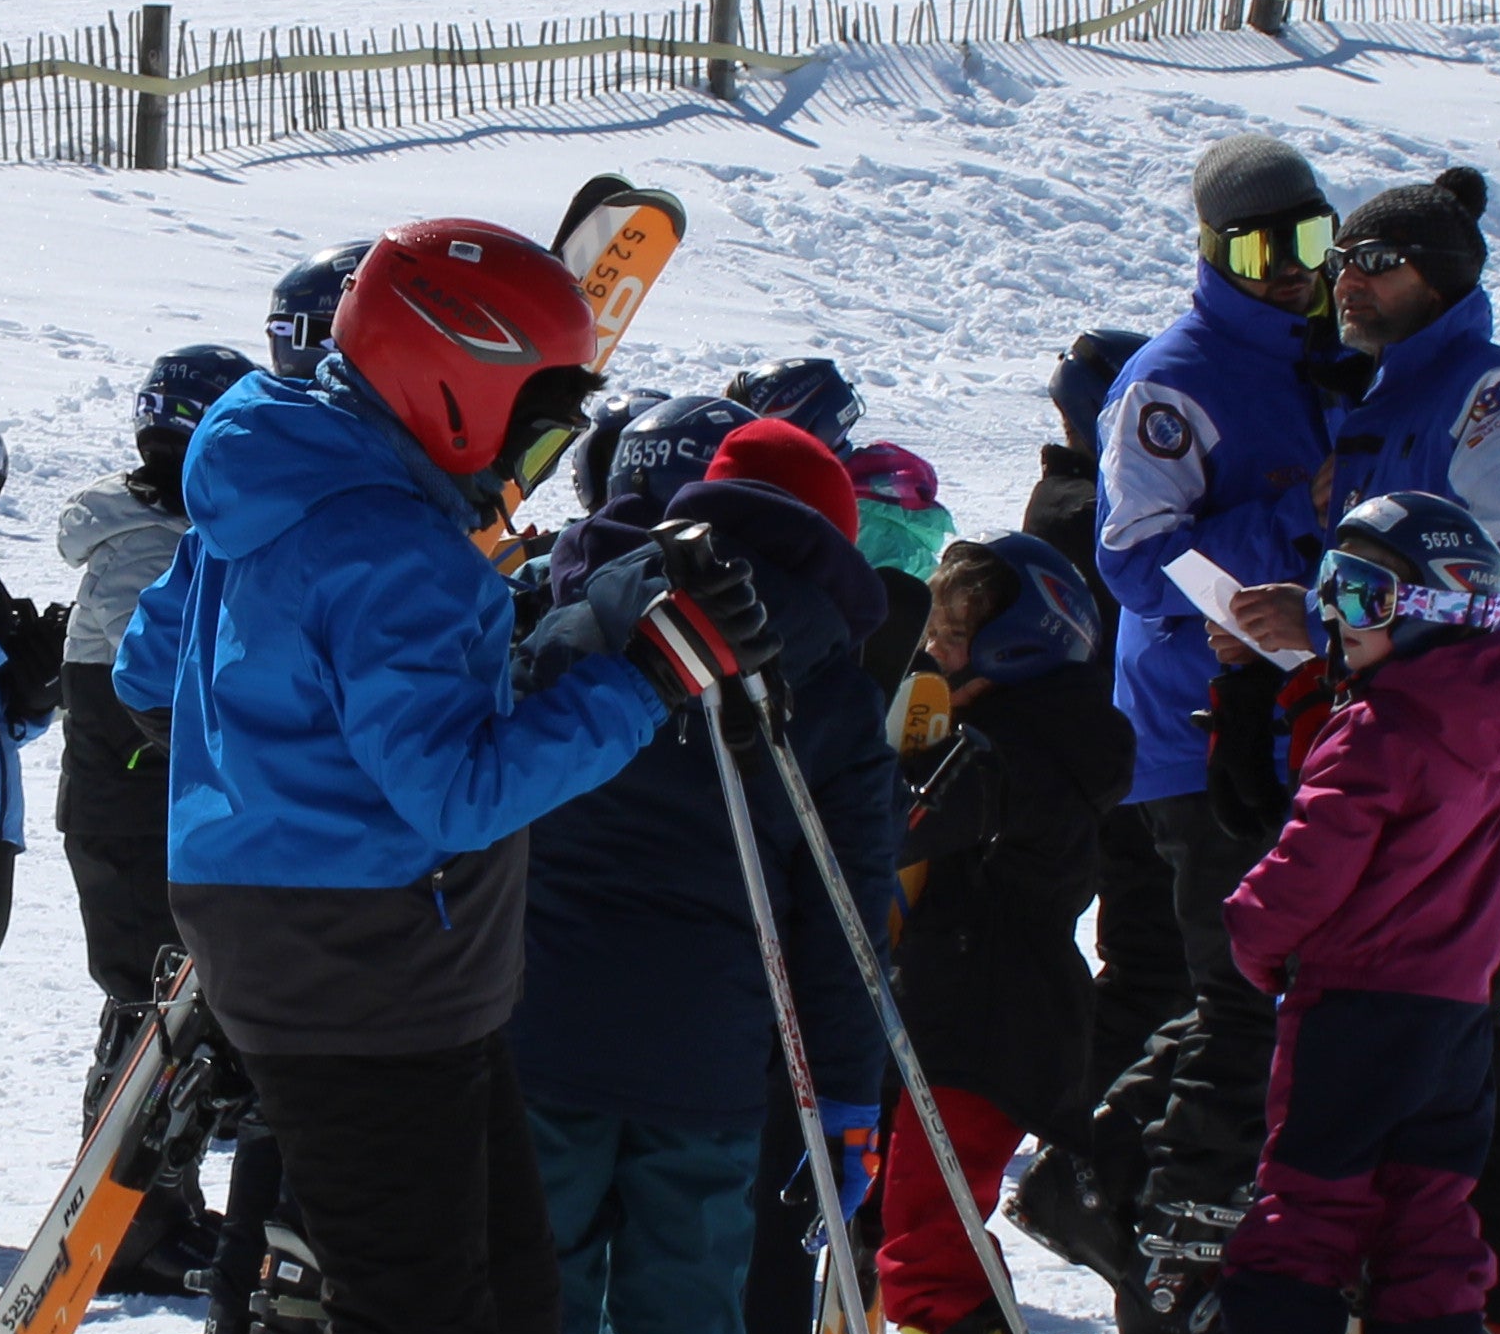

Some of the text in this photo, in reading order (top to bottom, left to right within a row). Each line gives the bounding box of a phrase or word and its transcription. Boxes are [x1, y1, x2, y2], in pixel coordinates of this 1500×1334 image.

[586, 227, 645, 299] 5259
[620, 438, 672, 468] 5659
[1421, 532, 1460, 550] 5650
